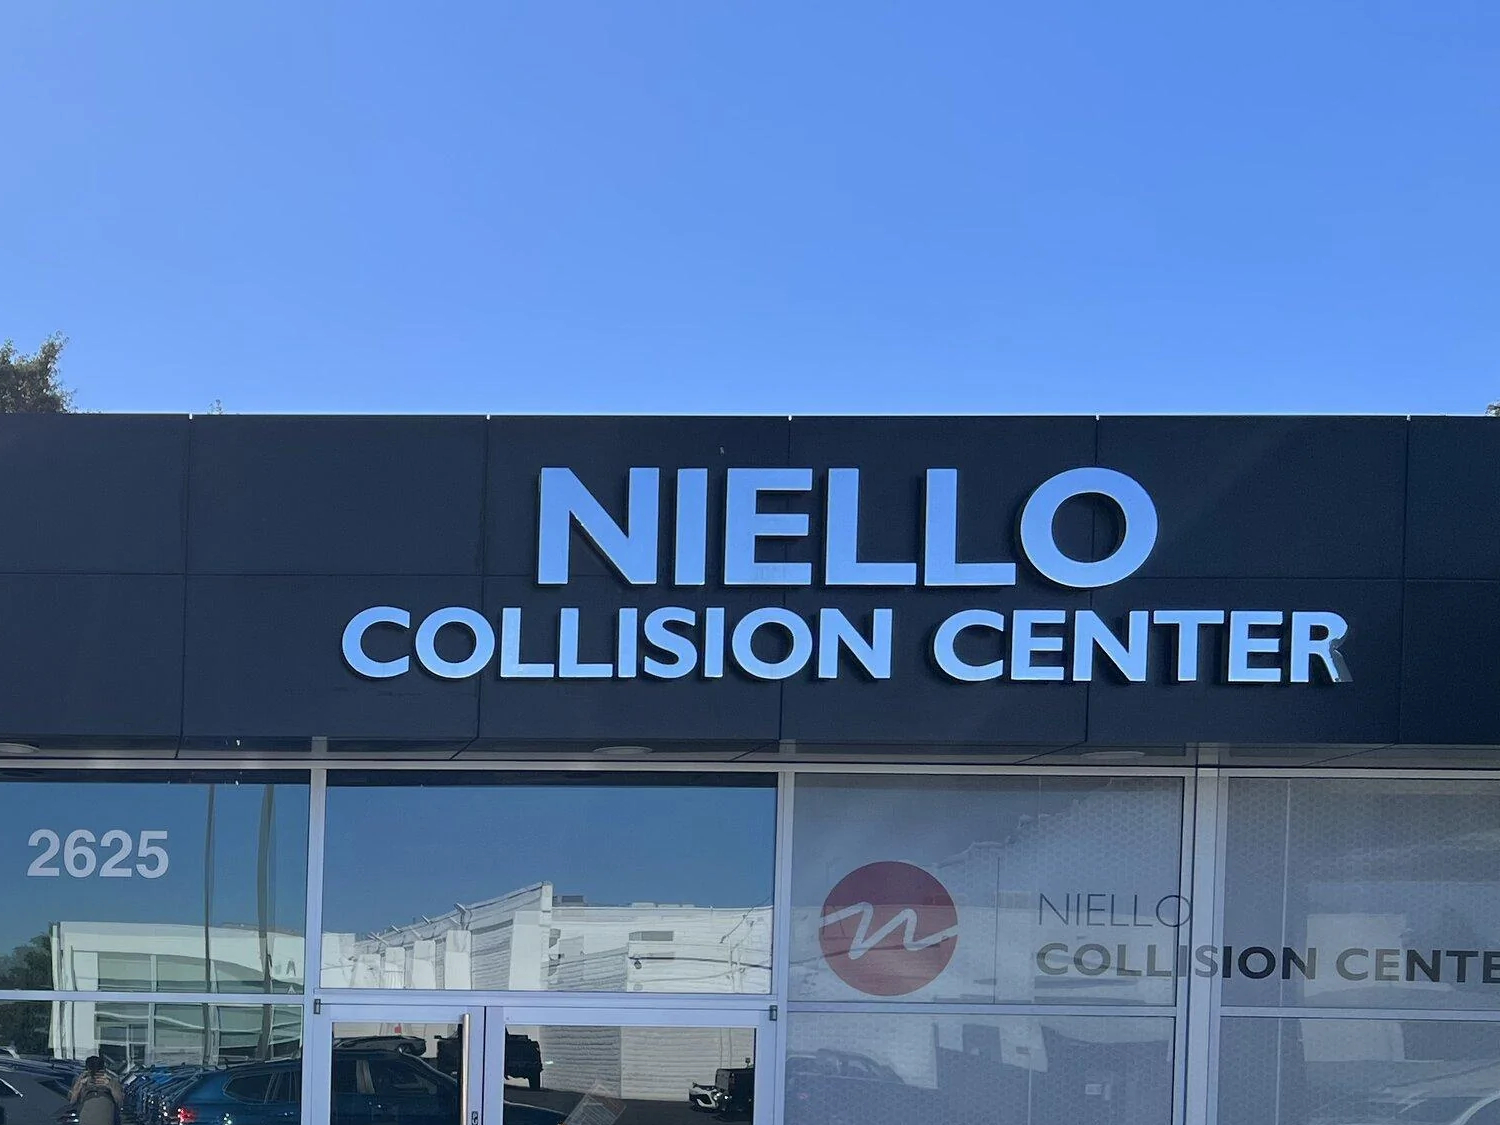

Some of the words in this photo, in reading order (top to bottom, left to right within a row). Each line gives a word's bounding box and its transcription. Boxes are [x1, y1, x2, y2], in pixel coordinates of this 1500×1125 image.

[537, 466, 1158, 588] NIELLO
[341, 606, 893, 679] COLLISION
[932, 608, 1353, 684] CENTER
[27, 829, 169, 879] 2625
[1038, 892, 1194, 929] NIELLO
[1036, 942, 1317, 981] COLLISION
